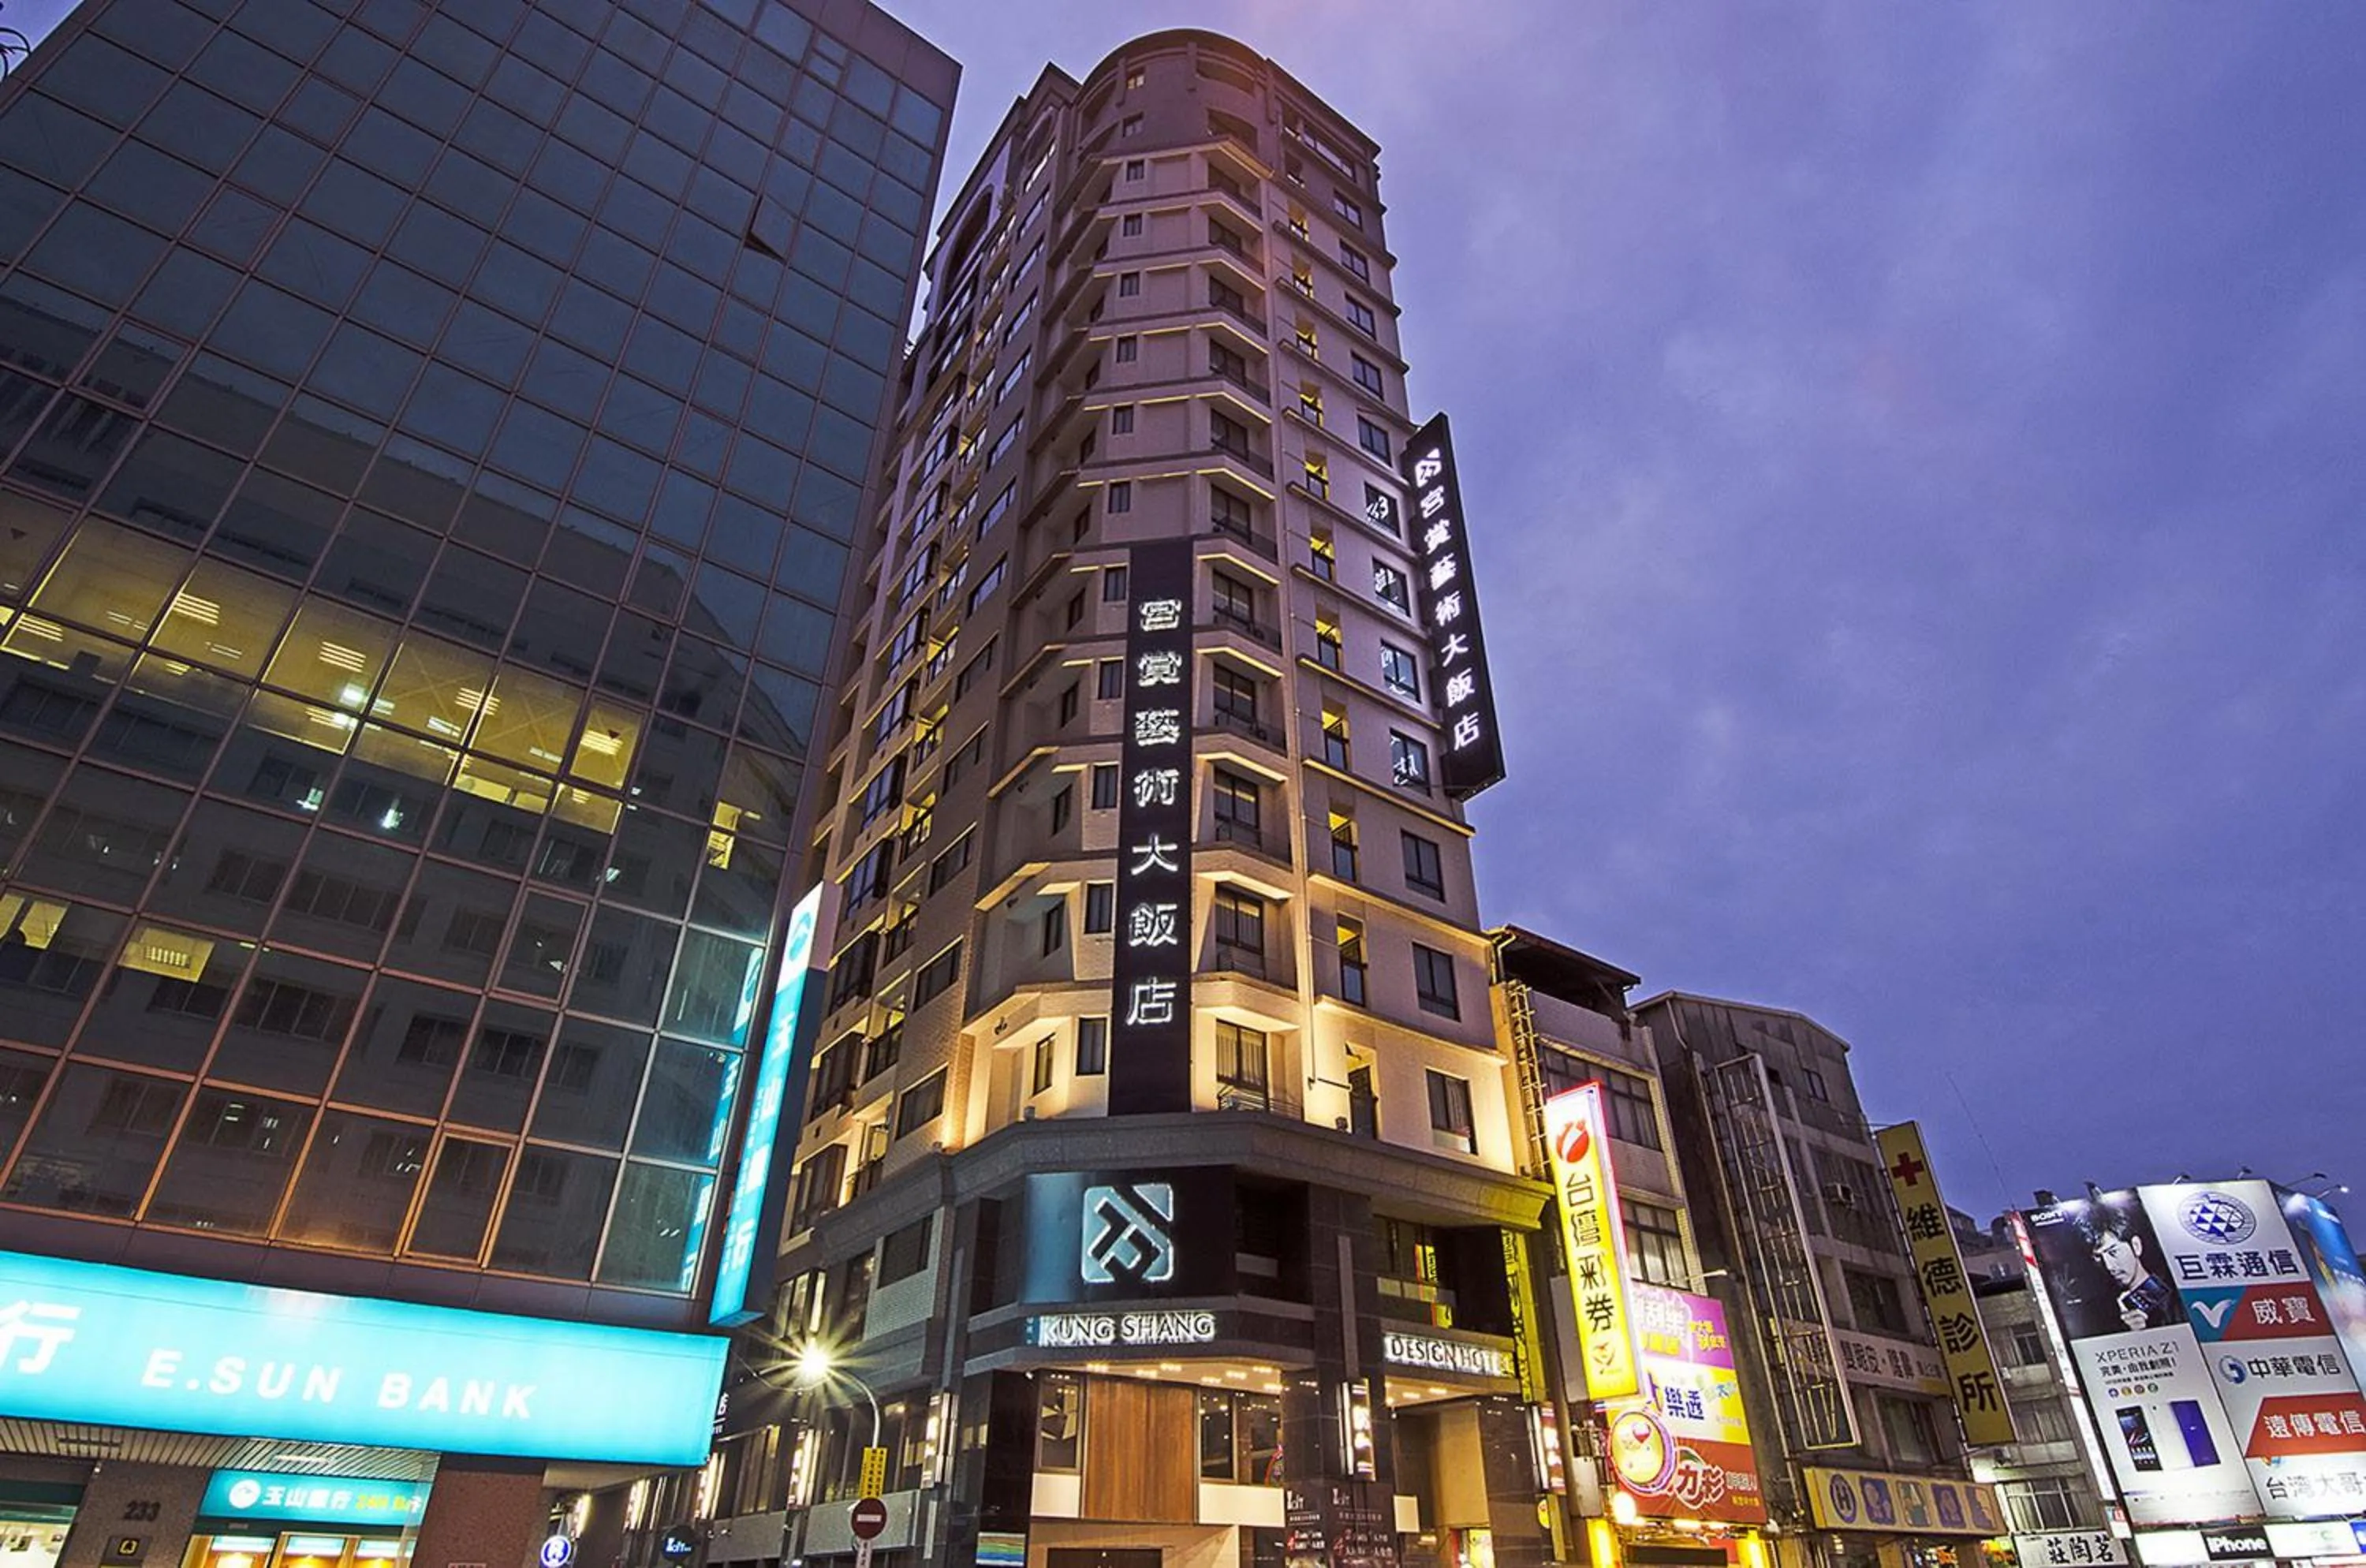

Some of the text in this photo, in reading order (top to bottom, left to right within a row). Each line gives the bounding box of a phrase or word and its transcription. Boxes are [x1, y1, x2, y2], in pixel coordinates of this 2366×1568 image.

[2174, 1249, 2300, 1280] 巨霖通信
[1906, 1202, 1997, 1413] 維德診所
[2252, 1297, 2316, 1325] 威寶
[1039, 1309, 1217, 1346] KUNG SHANG
[1386, 1333, 1457, 1369] DESIGN
[2095, 1345, 2159, 1363] XPERIA
[2248, 1353, 2341, 1379] 中華電信
[141, 1350, 537, 1420] E.SUN BANK
[2266, 1472, 2366, 1499] 台灣大哥
